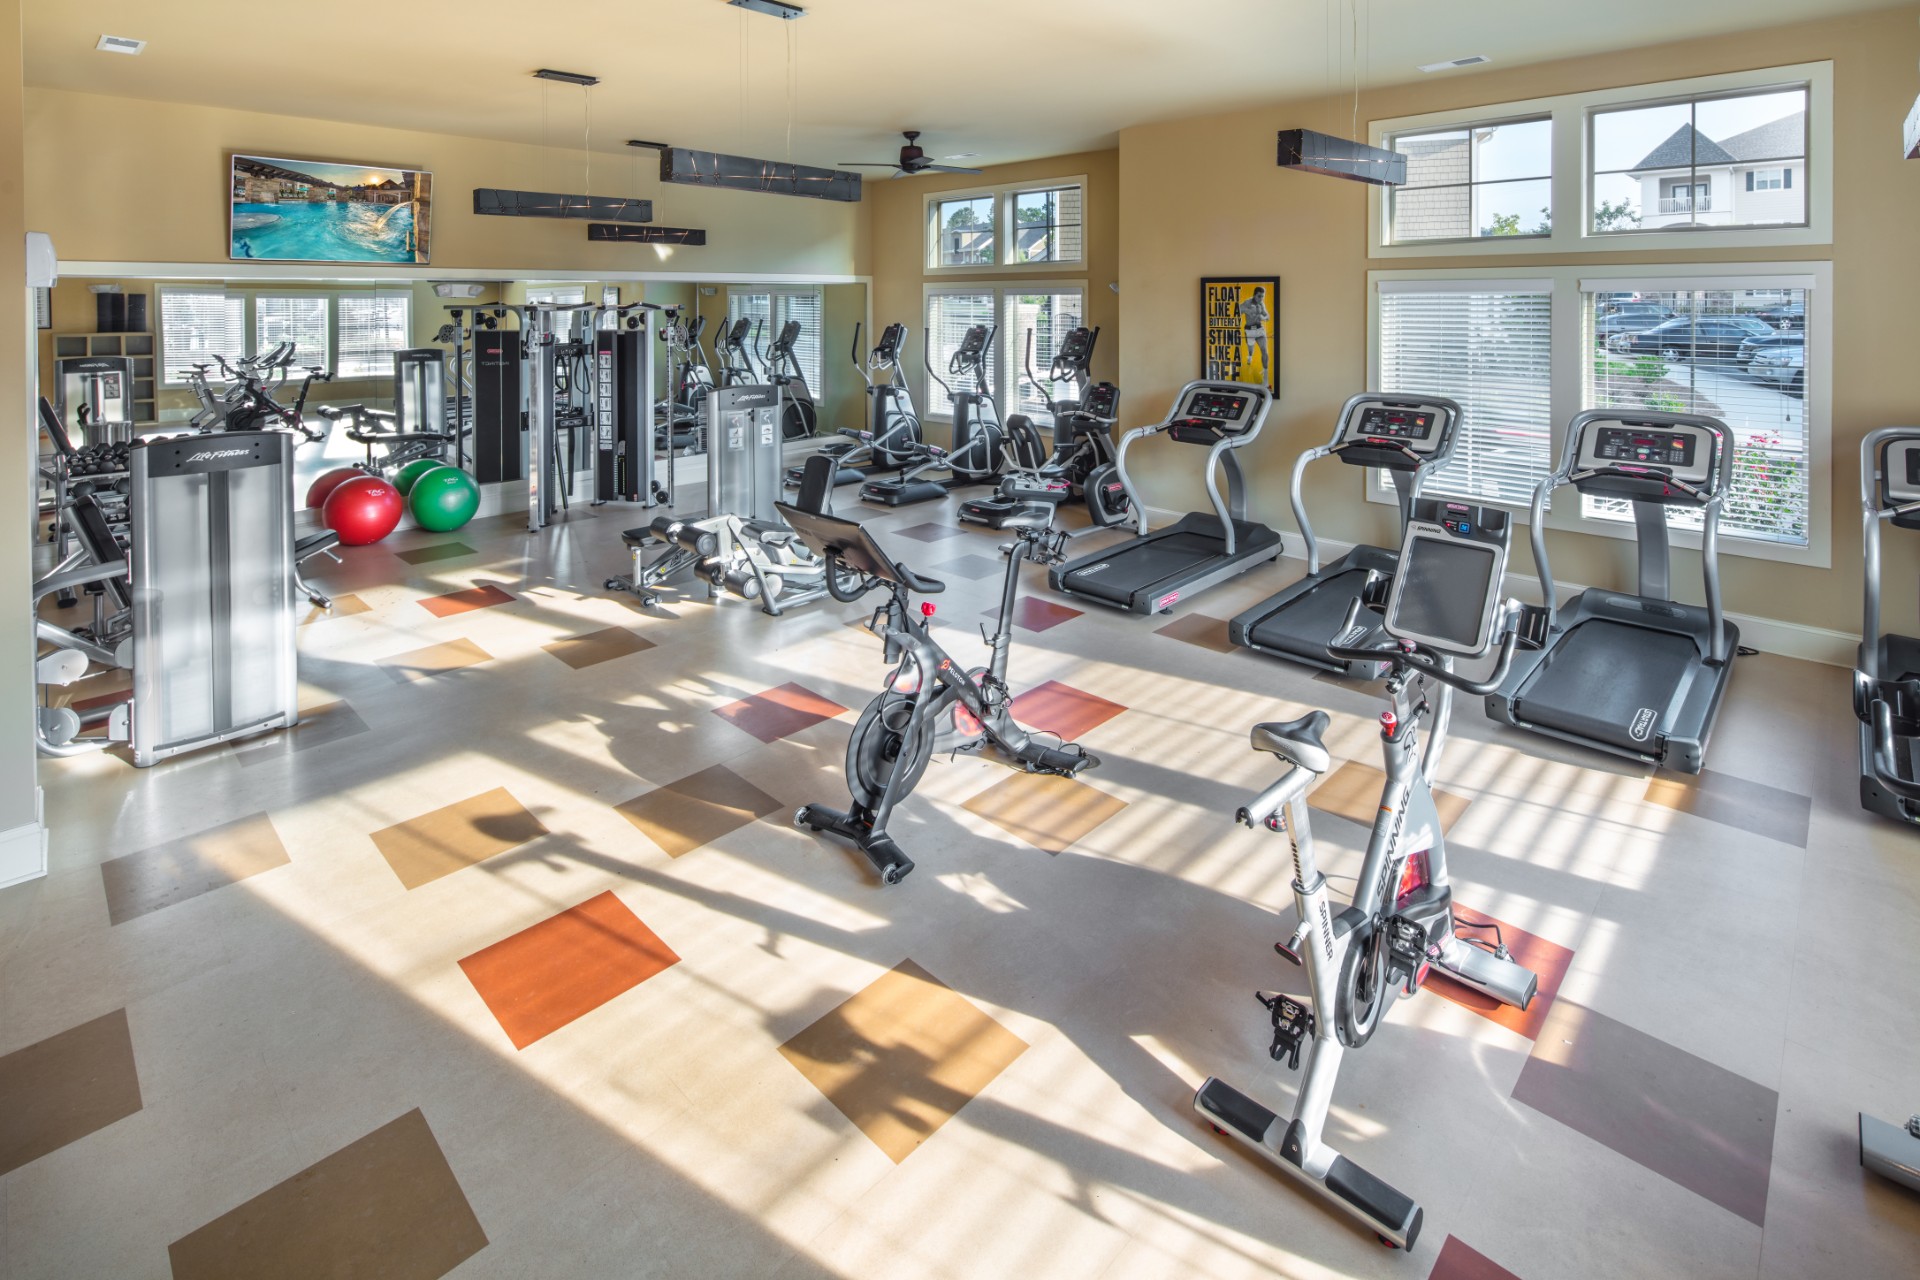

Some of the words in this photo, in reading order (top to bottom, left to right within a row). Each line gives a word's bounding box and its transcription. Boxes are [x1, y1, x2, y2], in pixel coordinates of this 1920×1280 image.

[1209, 286, 1241, 301] FLOAT
[1209, 302, 1230, 317] LIKE
[1234, 302, 1240, 317] A
[1209, 317, 1241, 327] BUTTERFLY
[1209, 329, 1241, 345] STING
[1209, 345, 1230, 360] LIKE
[1234, 345, 1240, 360] A
[186, 452, 211, 462] Life
[210, 449, 250, 461] Fitness
[1417, 526, 1441, 534] SPINNING
[948, 665, 966, 686] PELOTON
[1377, 785, 1410, 903] SPINNING
[1319, 900, 1333, 961] SPINNER
